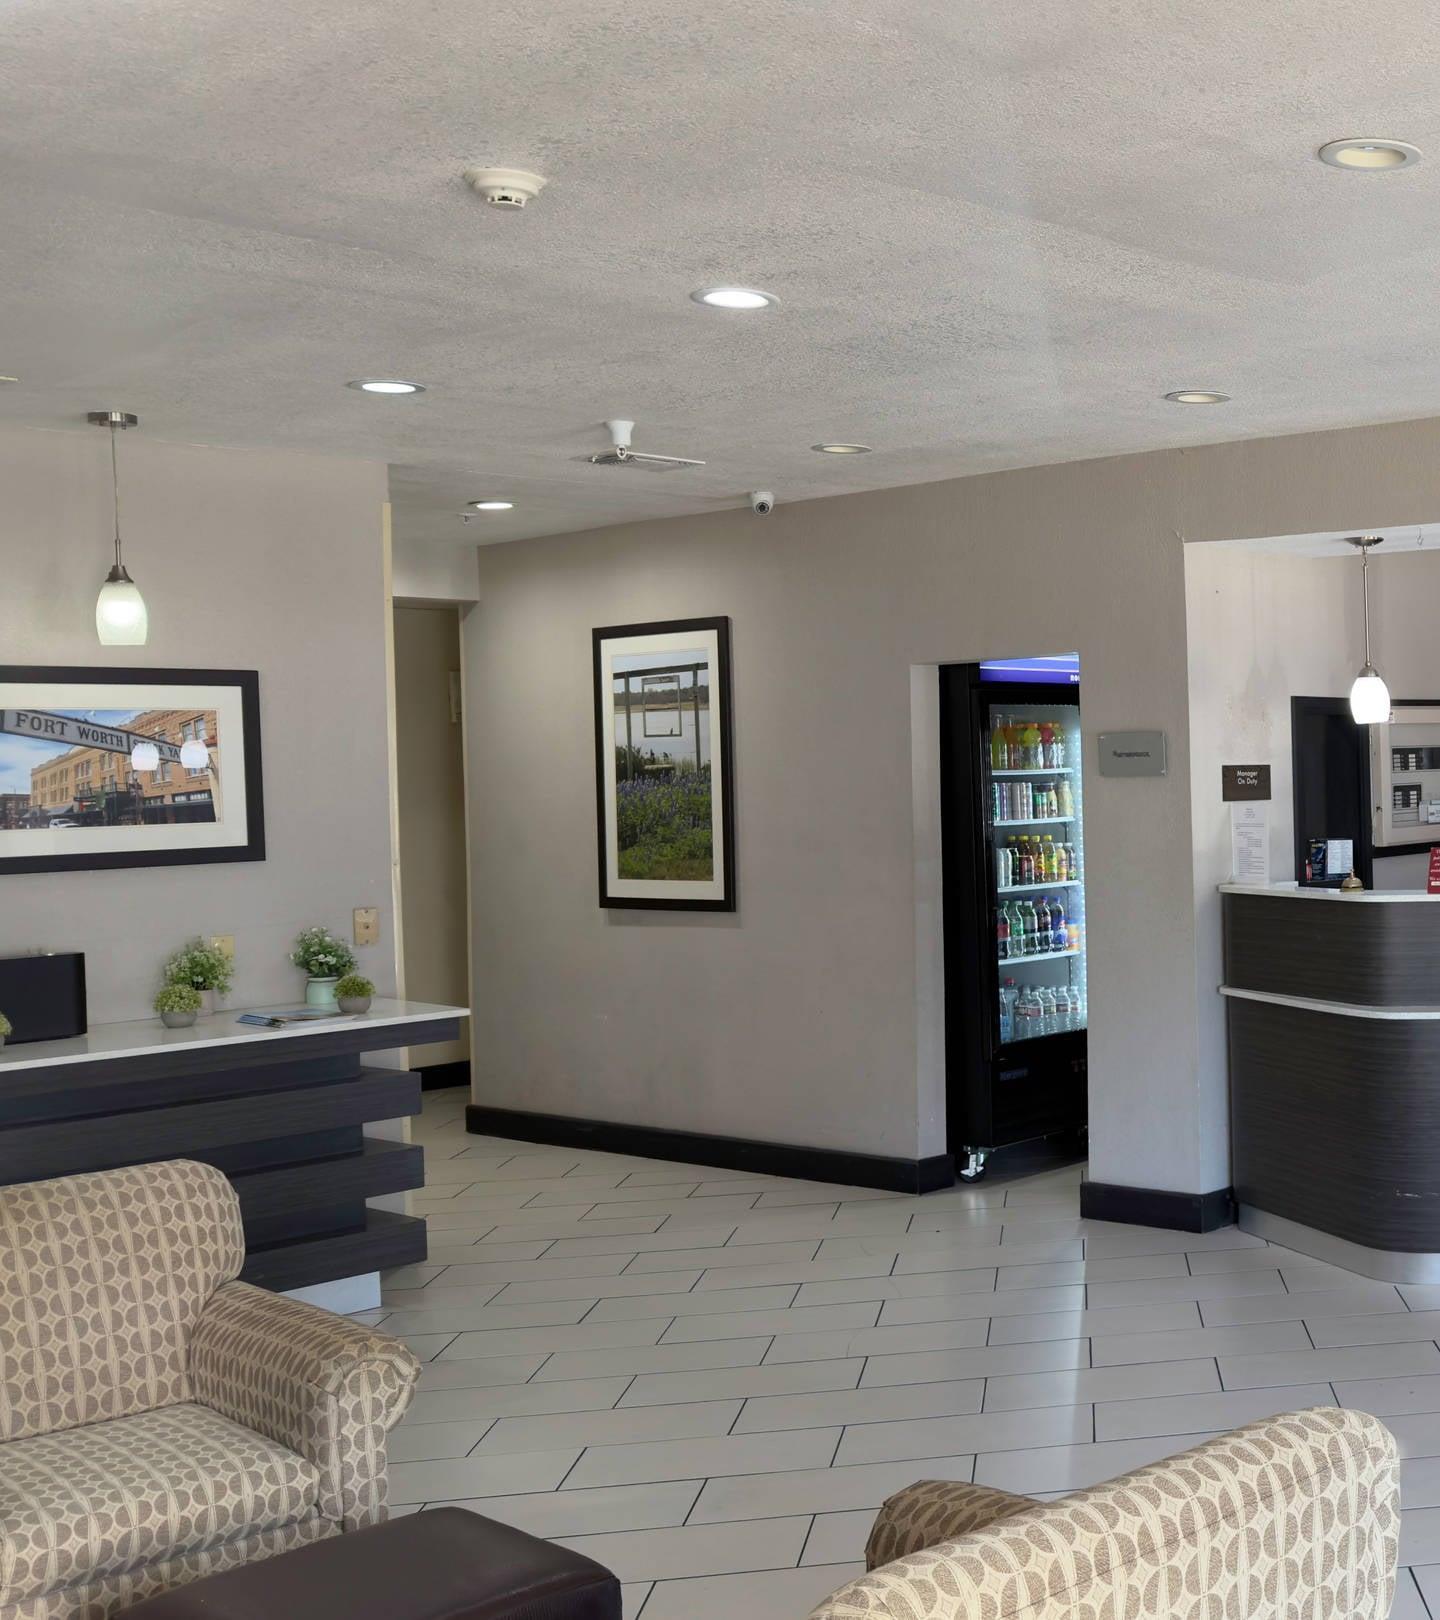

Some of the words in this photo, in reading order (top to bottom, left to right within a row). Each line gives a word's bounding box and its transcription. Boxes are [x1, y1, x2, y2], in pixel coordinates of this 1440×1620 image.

[15, 712, 68, 736] FORT
[77, 725, 124, 747] WORTH
[1237, 770, 1258, 778] Manager
[1247, 778, 1258, 786] Duty
